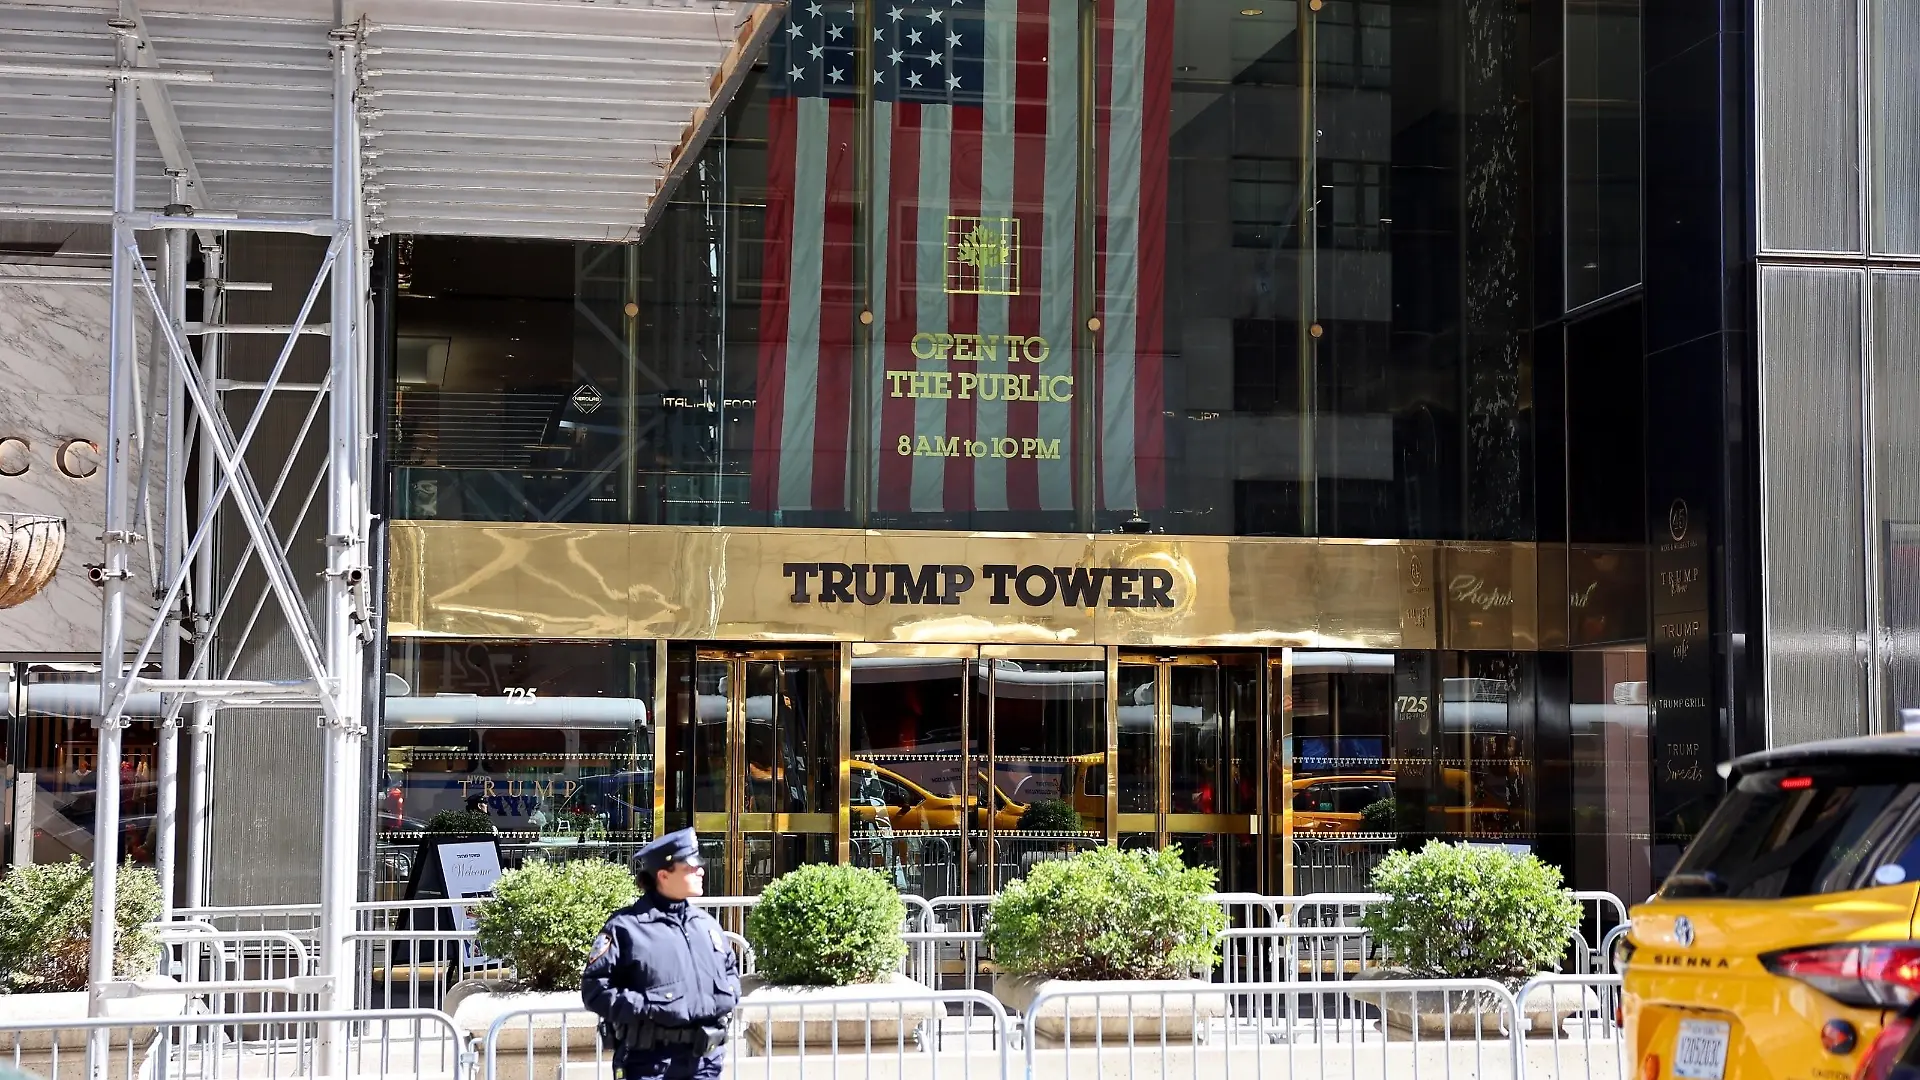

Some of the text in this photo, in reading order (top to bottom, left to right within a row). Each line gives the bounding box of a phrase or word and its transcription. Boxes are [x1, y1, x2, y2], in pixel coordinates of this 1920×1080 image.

[911, 333, 1050, 363] OPEN TO
[886, 371, 1074, 402] THE PUBLIC
[964, 439, 987, 458] to
[1660, 567, 1699, 585] TRUMP
[782, 563, 1175, 608] TRUMP TOWER
[1661, 621, 1700, 638] TRUMP
[503, 687, 537, 705] 725
[1398, 697, 1428, 713] 725
[1659, 697, 1706, 708] TRUMP GRILL
[1667, 743, 1700, 756] TRUMP
[1666, 759, 1703, 782] Sweets
[458, 780, 578, 798] TRUMP
[452, 859, 492, 878] Welcome
[1654, 955, 1730, 968] SIENNA
